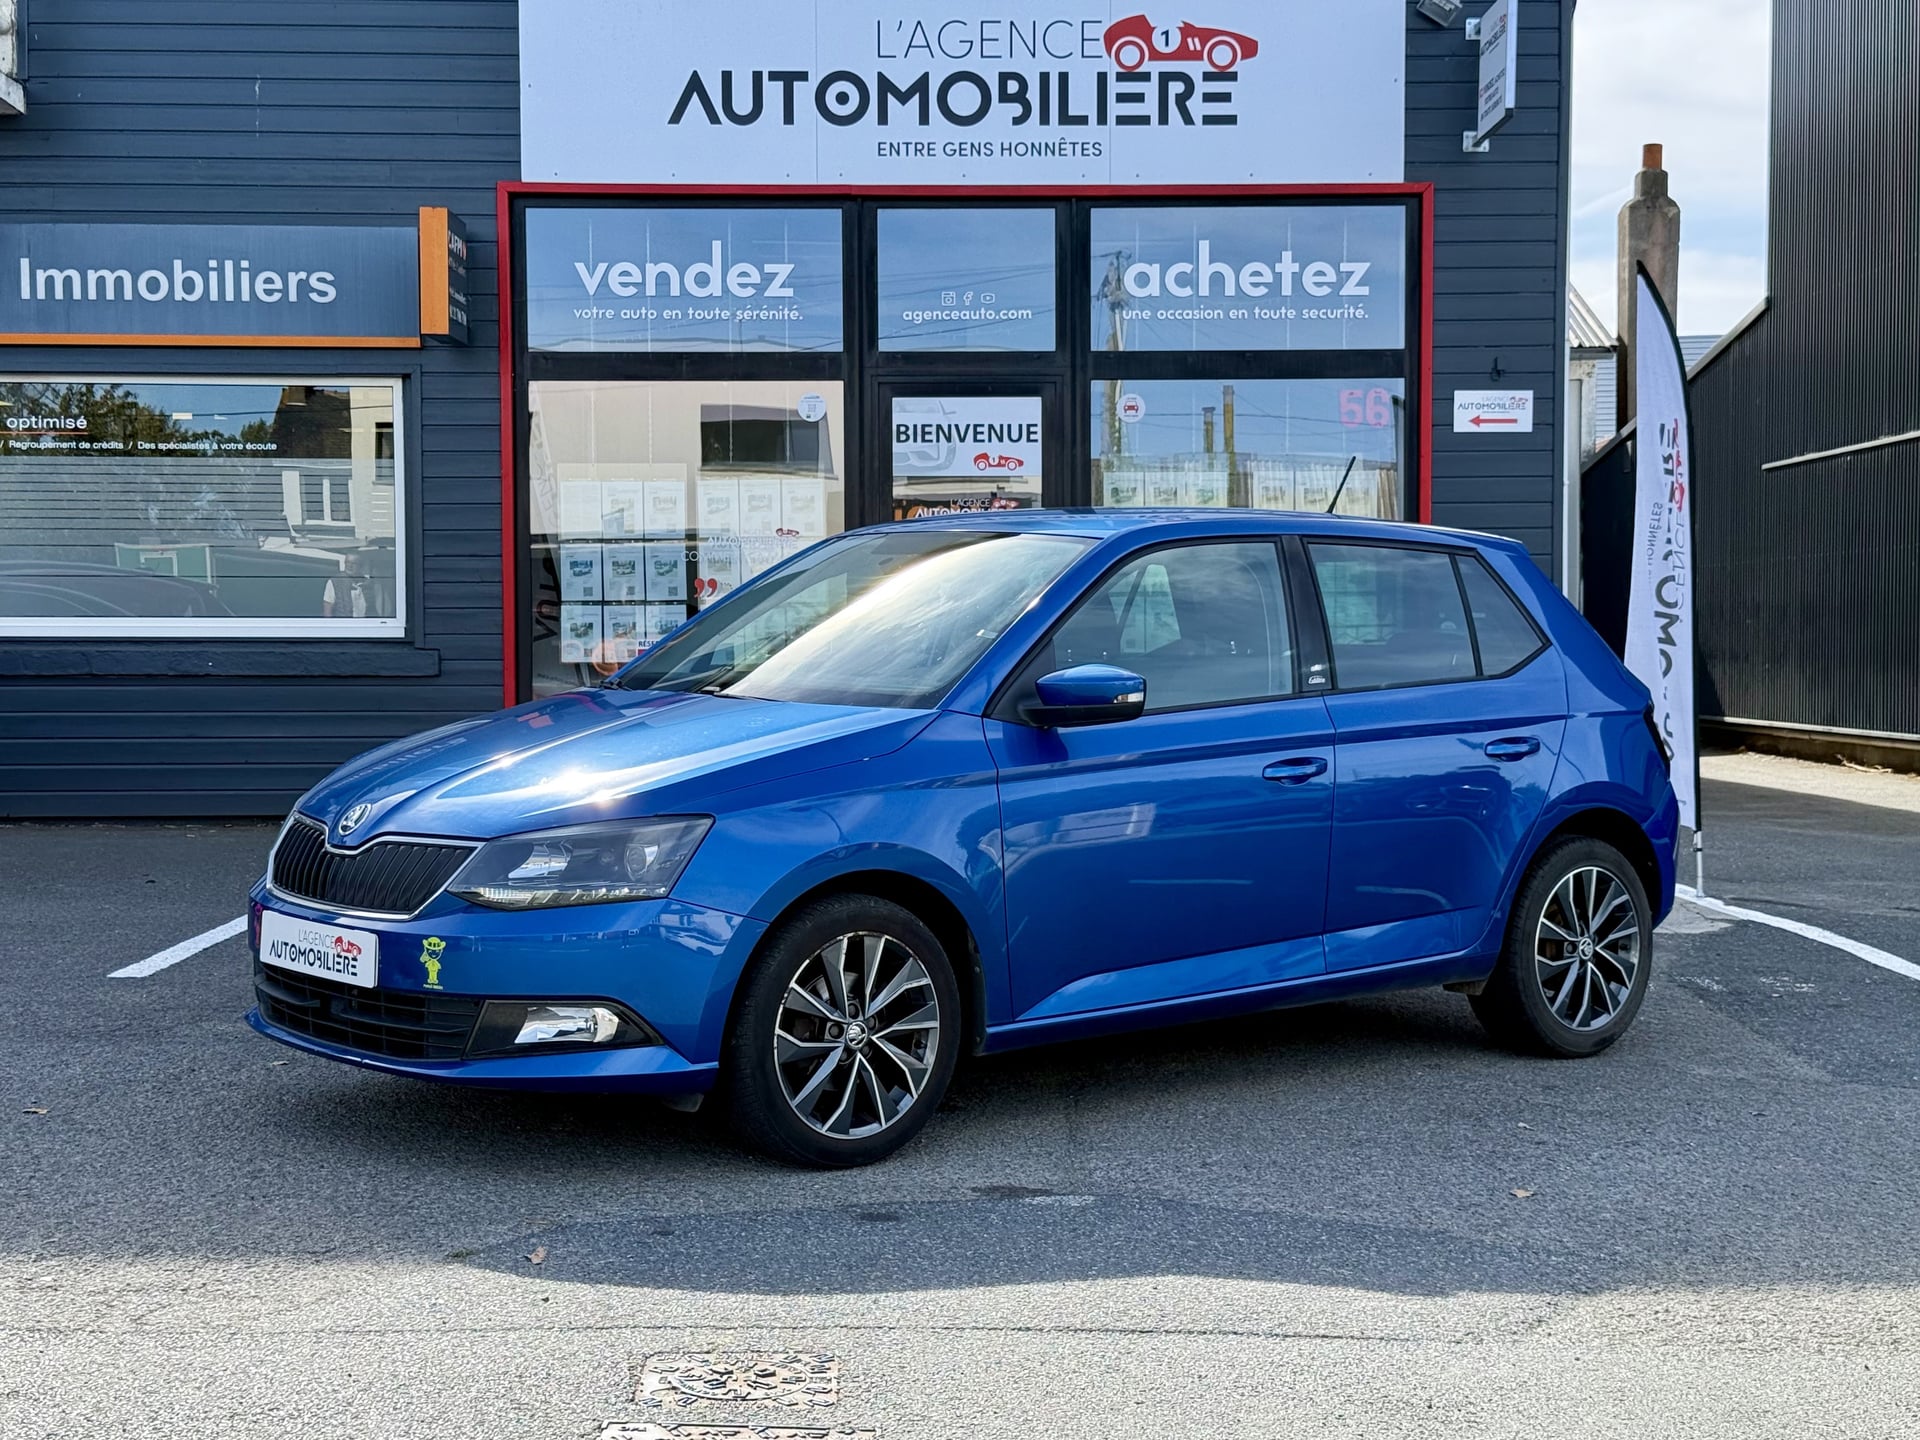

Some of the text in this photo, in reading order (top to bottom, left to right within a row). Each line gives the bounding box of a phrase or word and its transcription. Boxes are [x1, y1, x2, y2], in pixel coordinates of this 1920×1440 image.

[667, 70, 1238, 127] AUTOMOBILIERE
[877, 137, 1103, 157] ENTRE GENS HONNÊTES
[574, 240, 796, 298] vendez
[1123, 240, 1371, 298] achetez
[19, 256, 338, 304] Immobiliers
[573, 304, 804, 321] votre auto en toute sérénité.
[902, 307, 1032, 325] agenceauto.com
[1122, 303, 1369, 320] une occasion en toute securité.
[1339, 388, 1390, 428] 56
[6, 415, 88, 431] optimisé
[895, 423, 1039, 444] BIENVENUE
[9, 440, 77, 451] Regroupement
[79, 441, 91, 450] de
[93, 441, 124, 450] crédits
[137, 441, 156, 450] Des
[158, 441, 211, 451] spécialistes
[212, 441, 219, 450] à
[220, 442, 243, 450] votre
[246, 442, 278, 451] écoute
[269, 939, 358, 977] AUTOMOBILIERE
